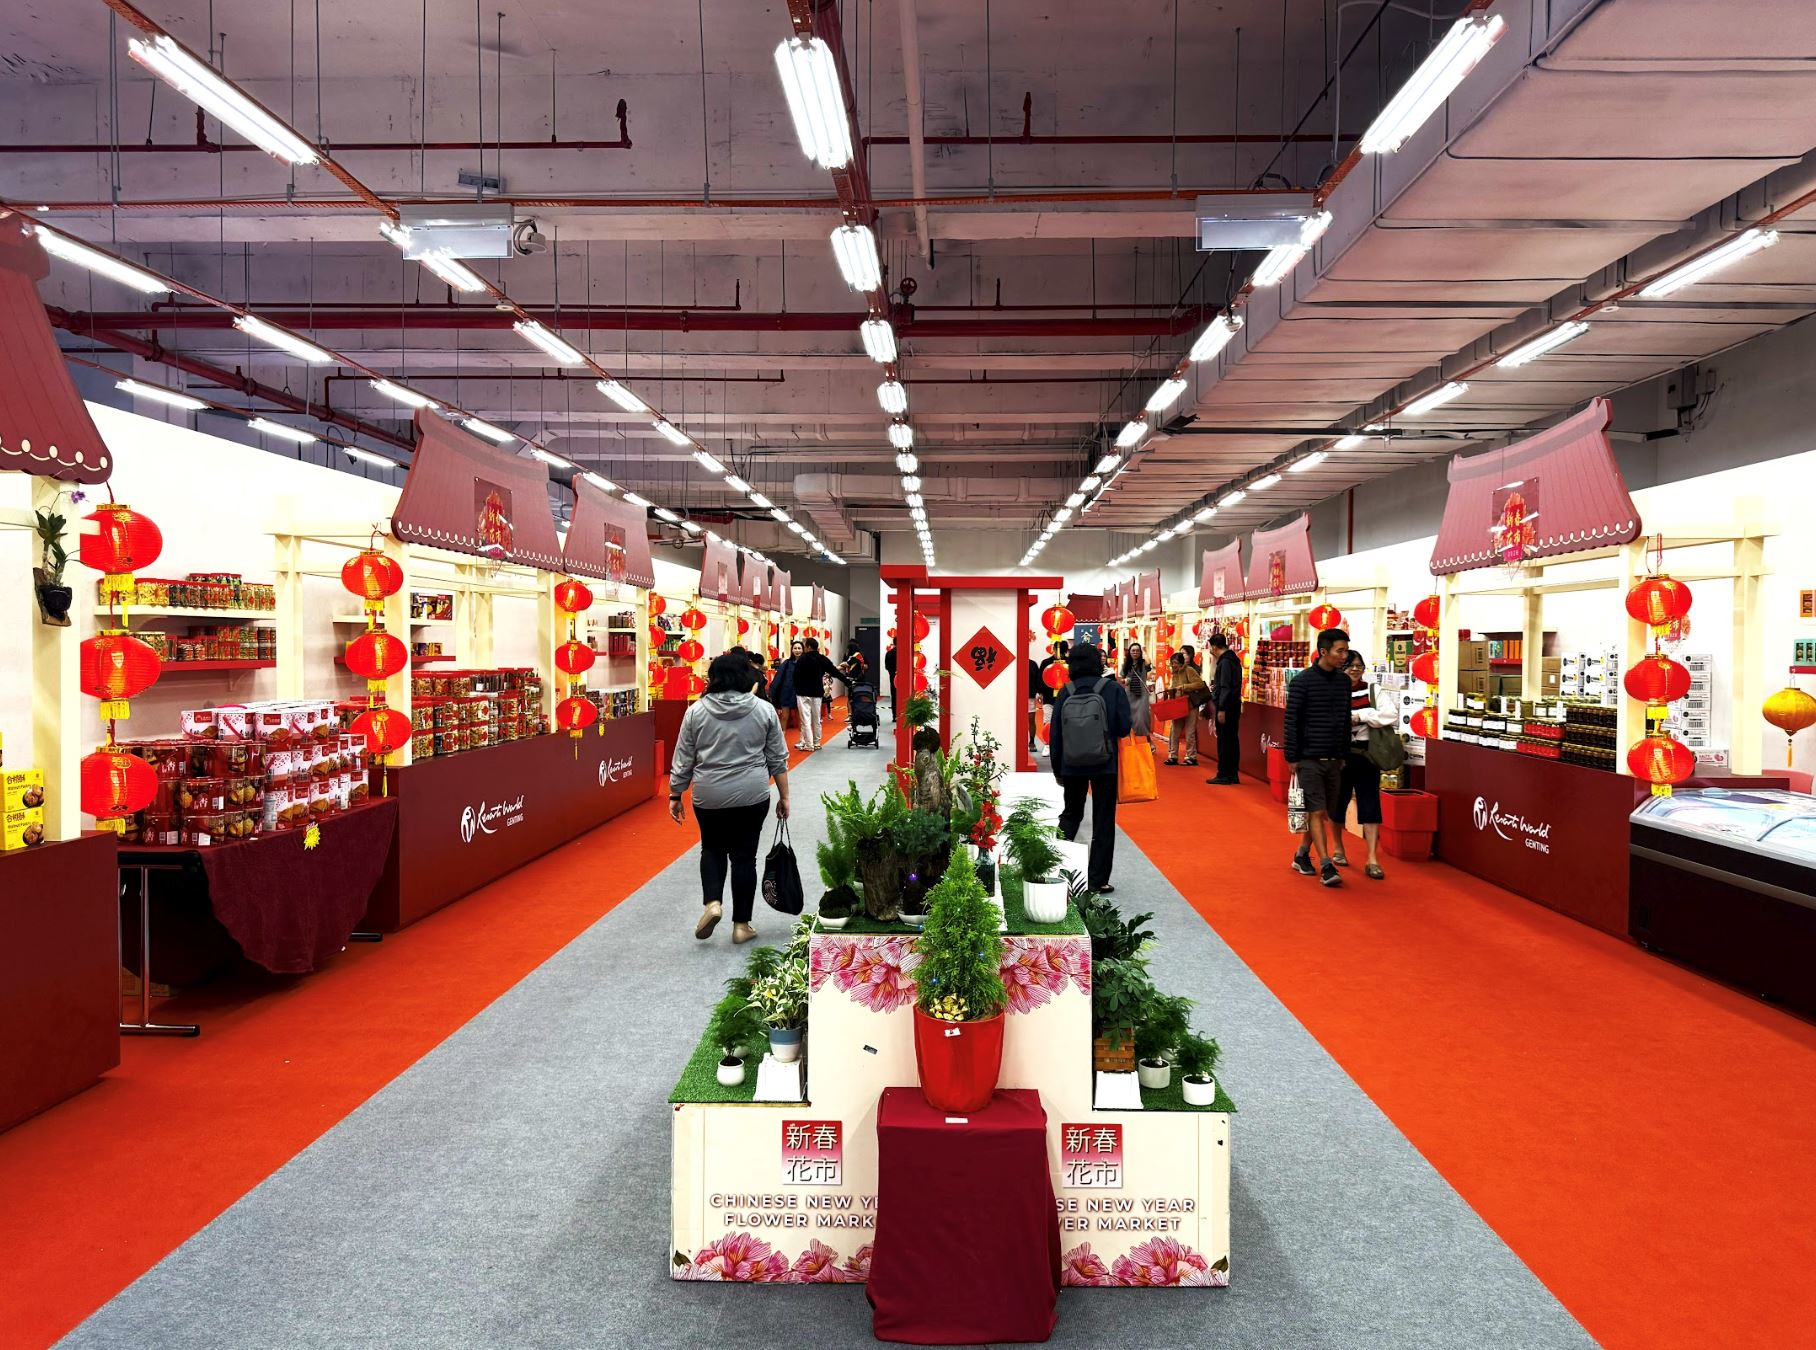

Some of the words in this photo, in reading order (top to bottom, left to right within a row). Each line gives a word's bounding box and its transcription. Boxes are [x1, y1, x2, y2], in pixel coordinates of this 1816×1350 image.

[1525, 838, 1550, 854] GENTING
[786, 1123, 838, 1151] 新春
[1065, 1127, 1118, 1154] 新春
[786, 1154, 839, 1183] 花市
[1066, 1158, 1119, 1186] 花市
[710, 1194, 798, 1210] CHINESE
[806, 1195, 852, 1210] NEW
[1087, 1199, 1134, 1213] NEW
[1143, 1199, 1195, 1213] YEAR
[723, 1213, 808, 1228] FLOWER
[1098, 1217, 1182, 1232] MARKET
